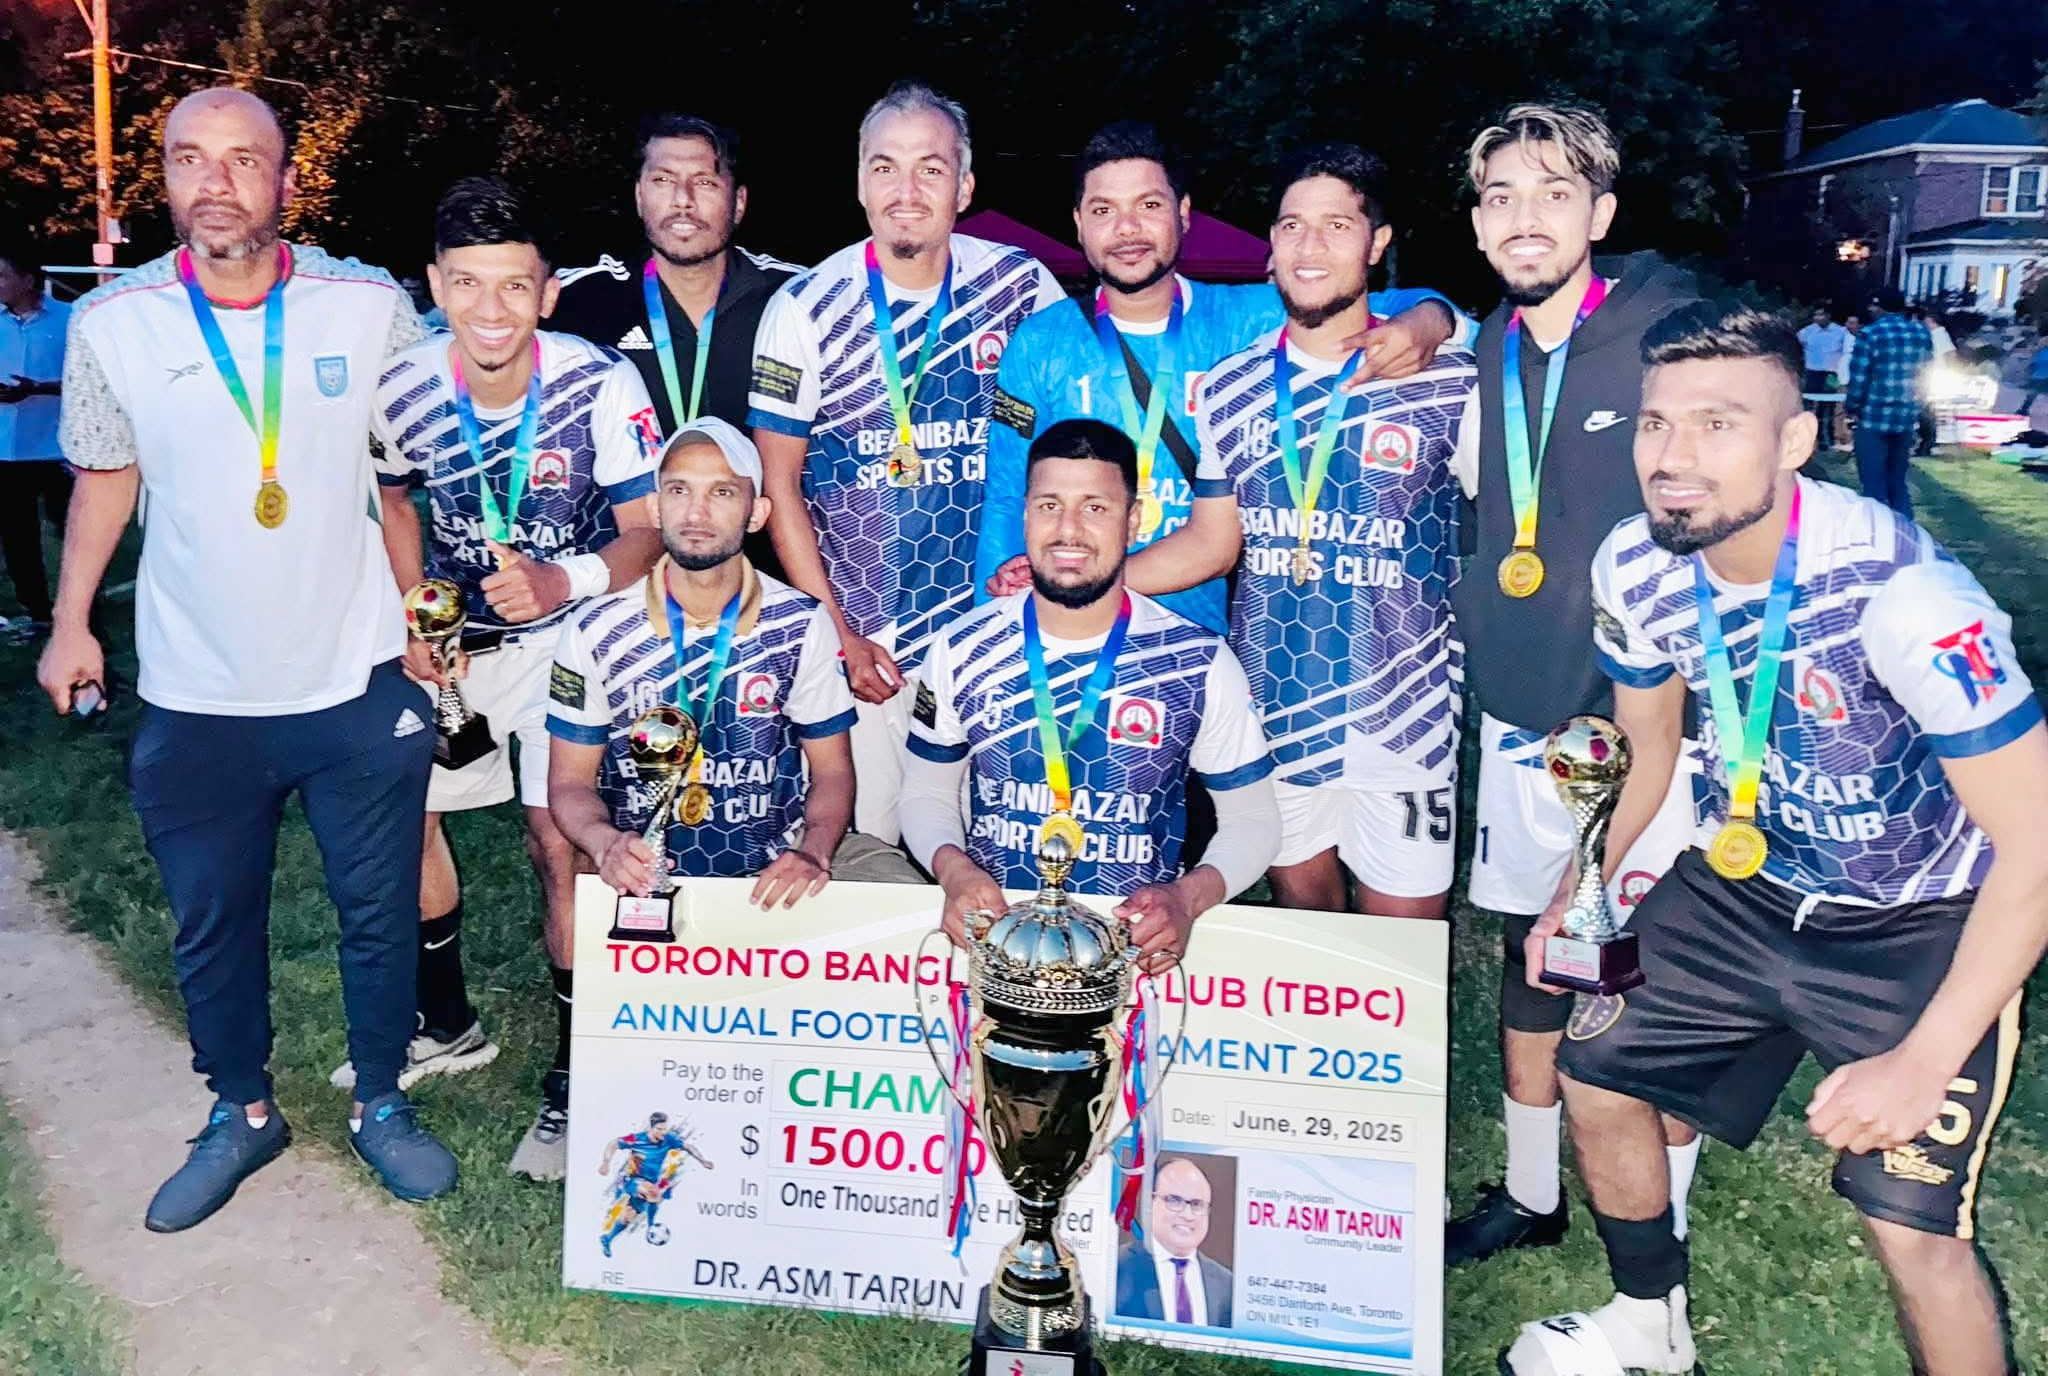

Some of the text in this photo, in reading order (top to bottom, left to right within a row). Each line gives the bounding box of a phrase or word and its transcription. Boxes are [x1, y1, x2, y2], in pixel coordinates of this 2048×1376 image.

[1076, 374, 1092, 414] 1
[1334, 554, 1404, 590] CLUB
[982, 687, 1005, 732] 5
[1394, 787, 1451, 844] 15
[1779, 800, 1887, 842] CLUB
[1077, 832, 1154, 866] CLUB
[1480, 825, 1490, 864] 1
[606, 943, 810, 980] TORONTO
[824, 950, 953, 986] BANGL
[1264, 976, 1406, 1027] (TBPC)
[611, 1002, 1405, 1083] ANNUAL FOOTBA AMENT 2025
[662, 1059, 764, 1083] Pay to the
[685, 1081, 765, 1104] order of
[740, 1124, 761, 1159] $
[1172, 1107, 1404, 1143] Date: June, 29, 2025
[740, 1178, 759, 1197] In
[780, 1182, 827, 1210] One
[832, 1185, 939, 1218] Thousand
[1248, 1187, 1334, 1204] Family Physician
[697, 1201, 758, 1220] words
[1248, 1201, 1403, 1240] DR. ASM TARUN
[1304, 1234, 1404, 1253] Community Leader
[601, 1271, 624, 1286] RE
[693, 1258, 965, 1310] DR. ASM TARUN
[1279, 1296, 1328, 1312] Danforth
[1359, 1304, 1404, 1321] Toronto
